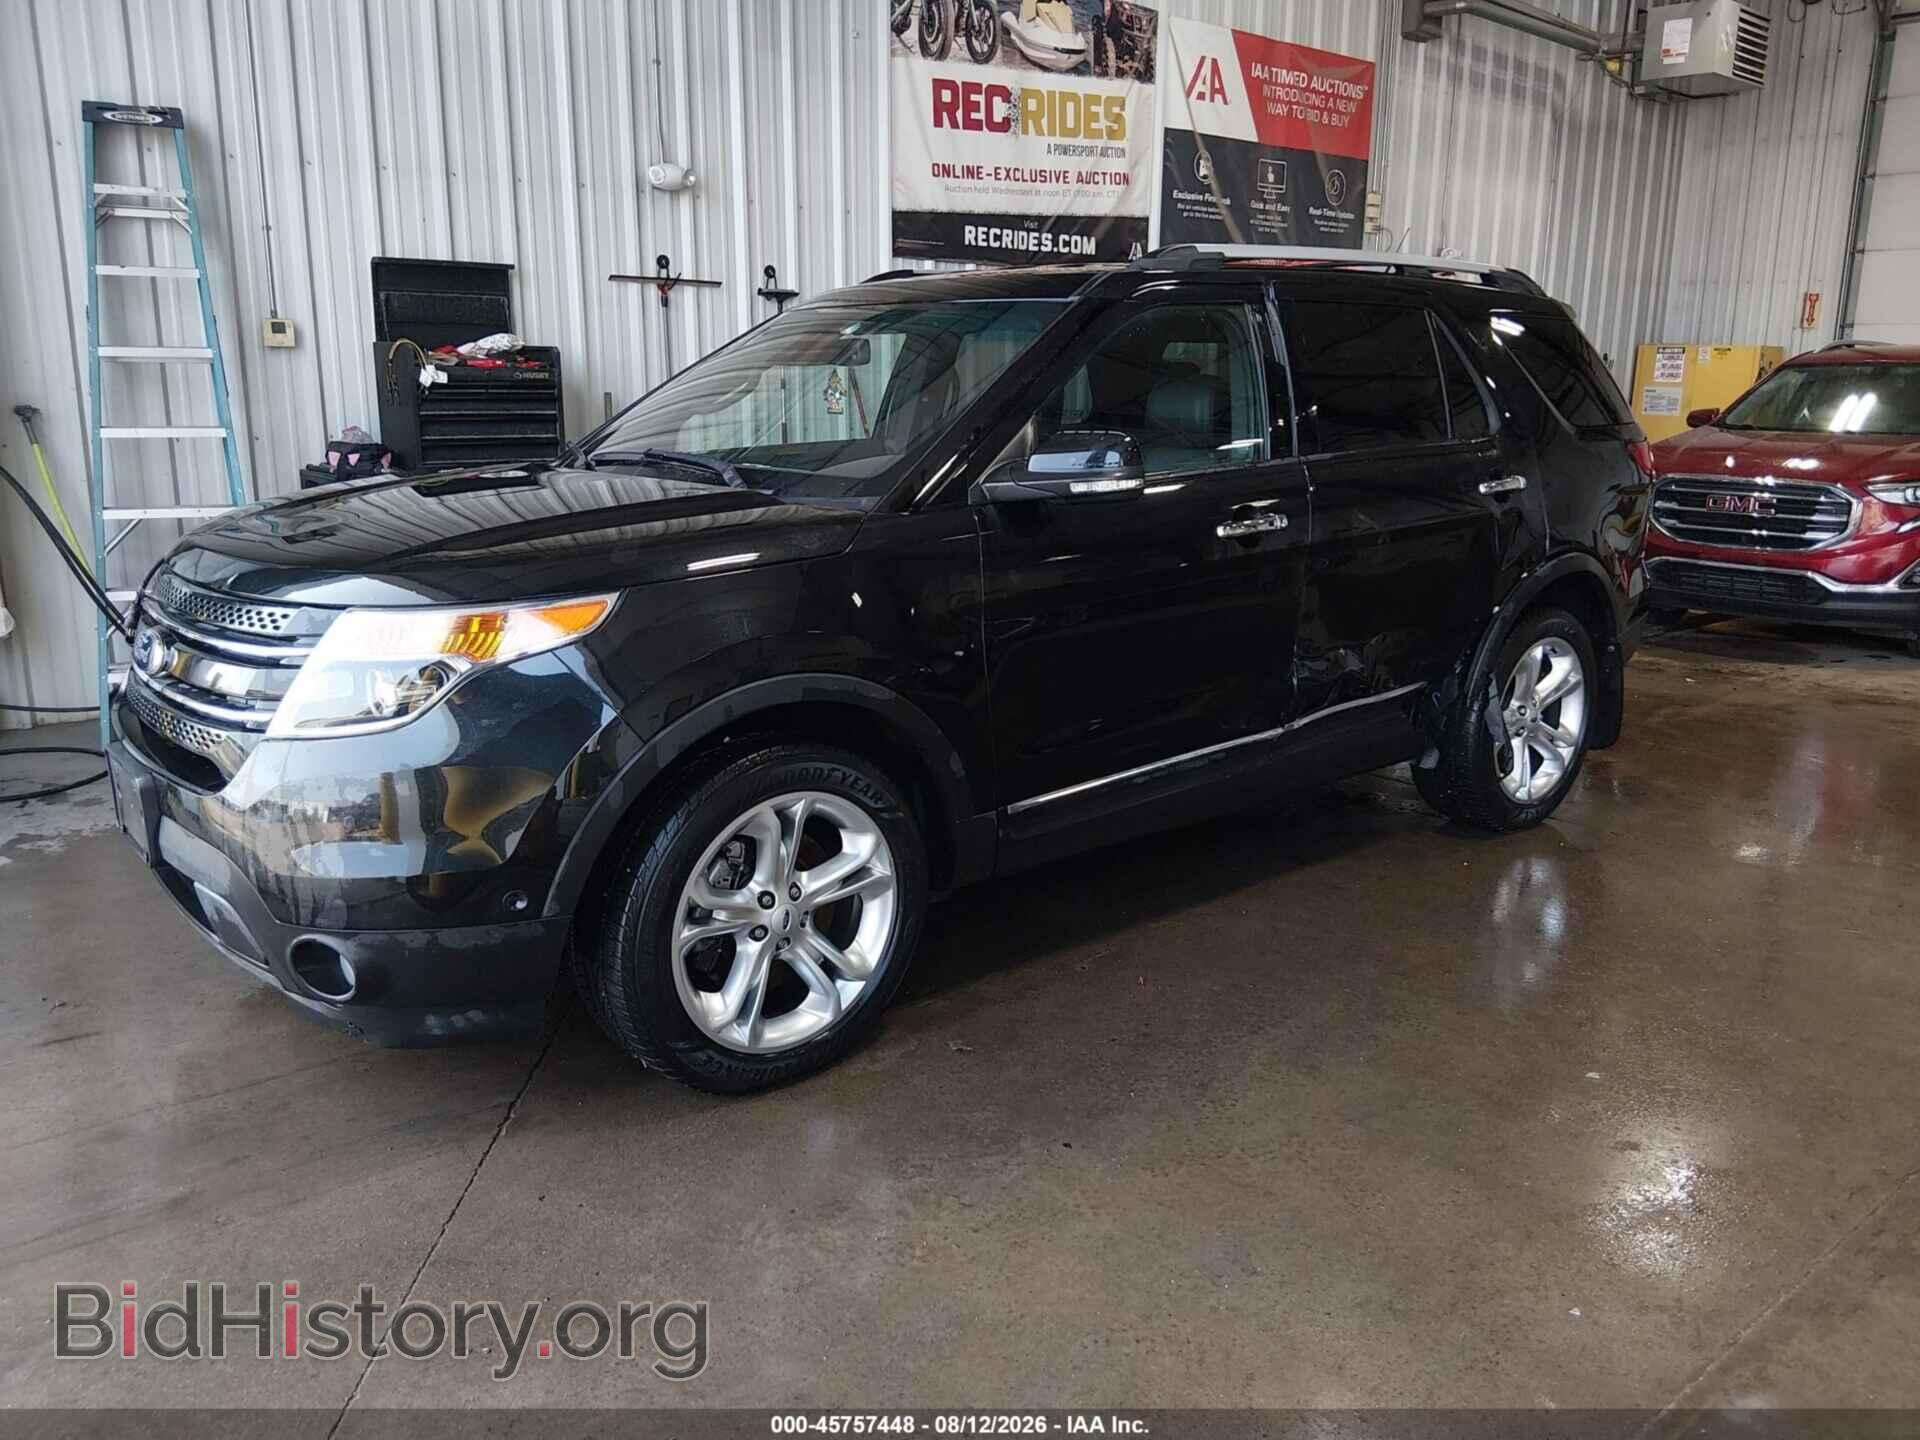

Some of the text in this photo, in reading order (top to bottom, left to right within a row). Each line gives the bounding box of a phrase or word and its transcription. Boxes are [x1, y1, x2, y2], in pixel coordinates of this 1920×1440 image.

[1251, 62, 1270, 81] IAA
[1271, 67, 1308, 88] TIMED
[932, 78, 1127, 142] REC RIDES
[1263, 84, 1357, 113] INTRODUCING A NEW
[1266, 102, 1289, 117] WAY
[1291, 105, 1306, 120] TO
[1321, 112, 1329, 124] &
[1330, 113, 1351, 128] BUY
[1046, 143, 1126, 159] A POWERSPORT AUCTION
[931, 162, 1129, 186] ONLINE-EXCLUSIVE AUCTION
[964, 225, 1096, 256] RECRIDES.COM
[1705, 494, 1777, 517] GMC
